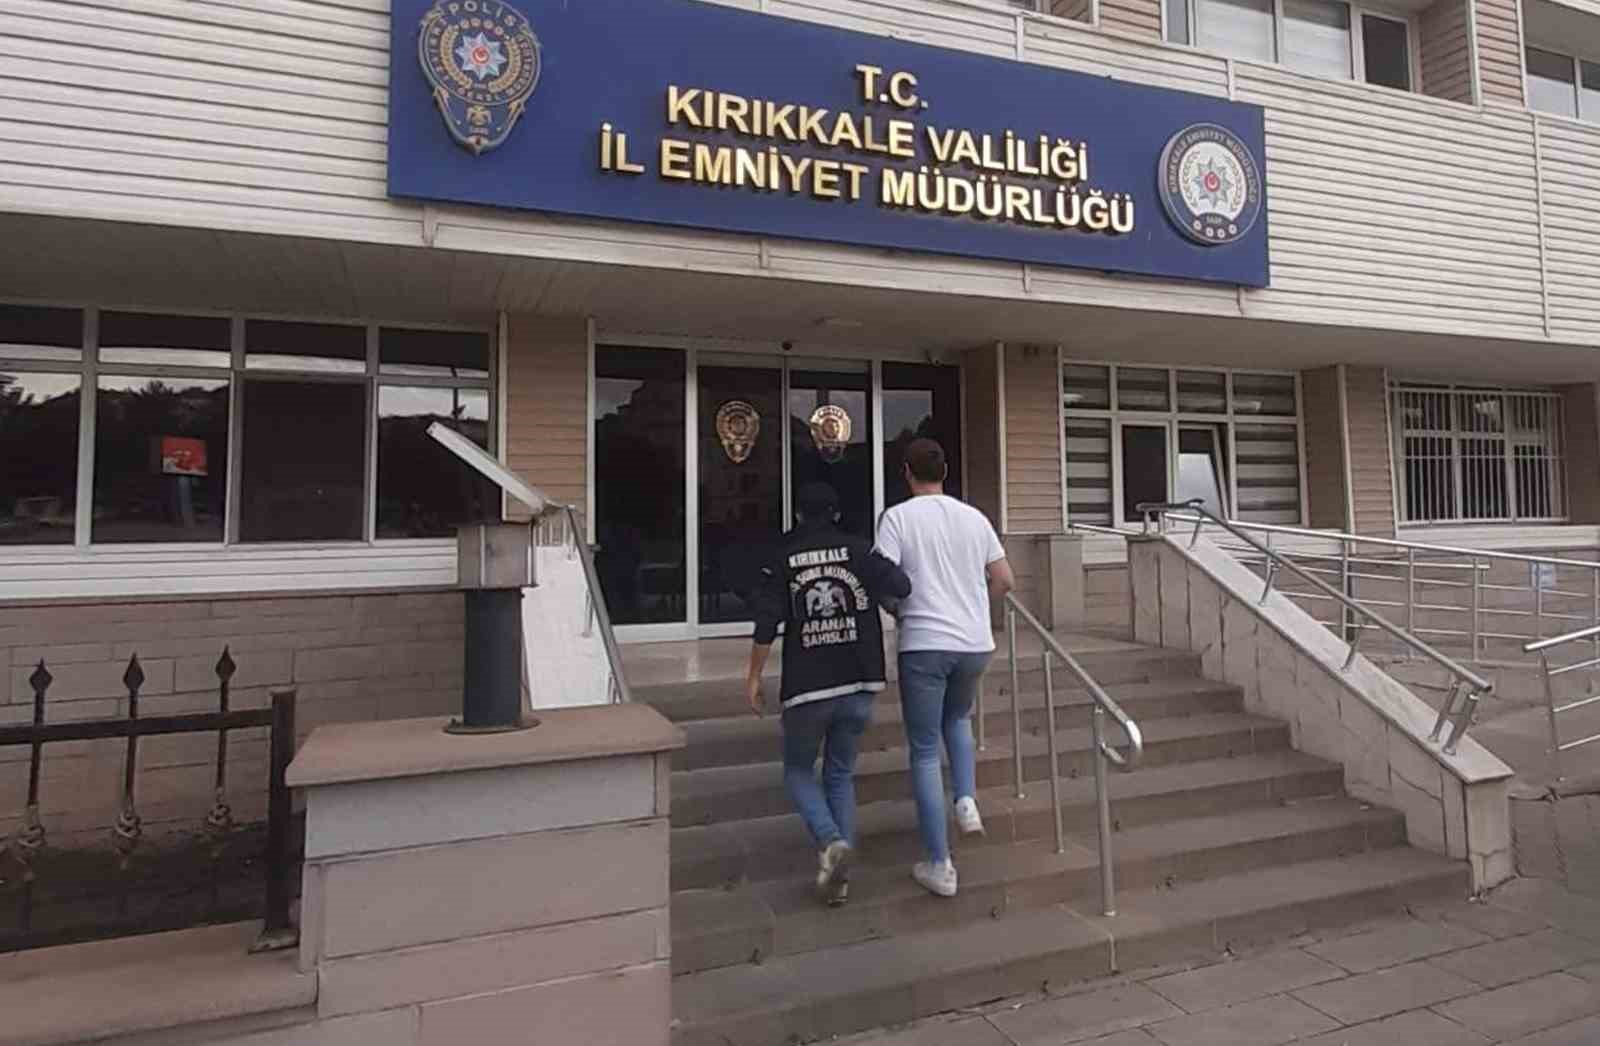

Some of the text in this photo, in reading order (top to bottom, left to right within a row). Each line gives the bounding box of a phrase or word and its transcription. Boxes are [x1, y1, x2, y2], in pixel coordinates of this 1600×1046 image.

[855, 63, 929, 109] T.C.
[667, 84, 1089, 182] KIRIKKALE VALİLİĞİ
[599, 121, 1135, 234] İL EMNİYET MÜDÜRLÜĞÜ
[789, 547, 848, 568] KIRIKKALE
[802, 617, 856, 634] ARANAN
